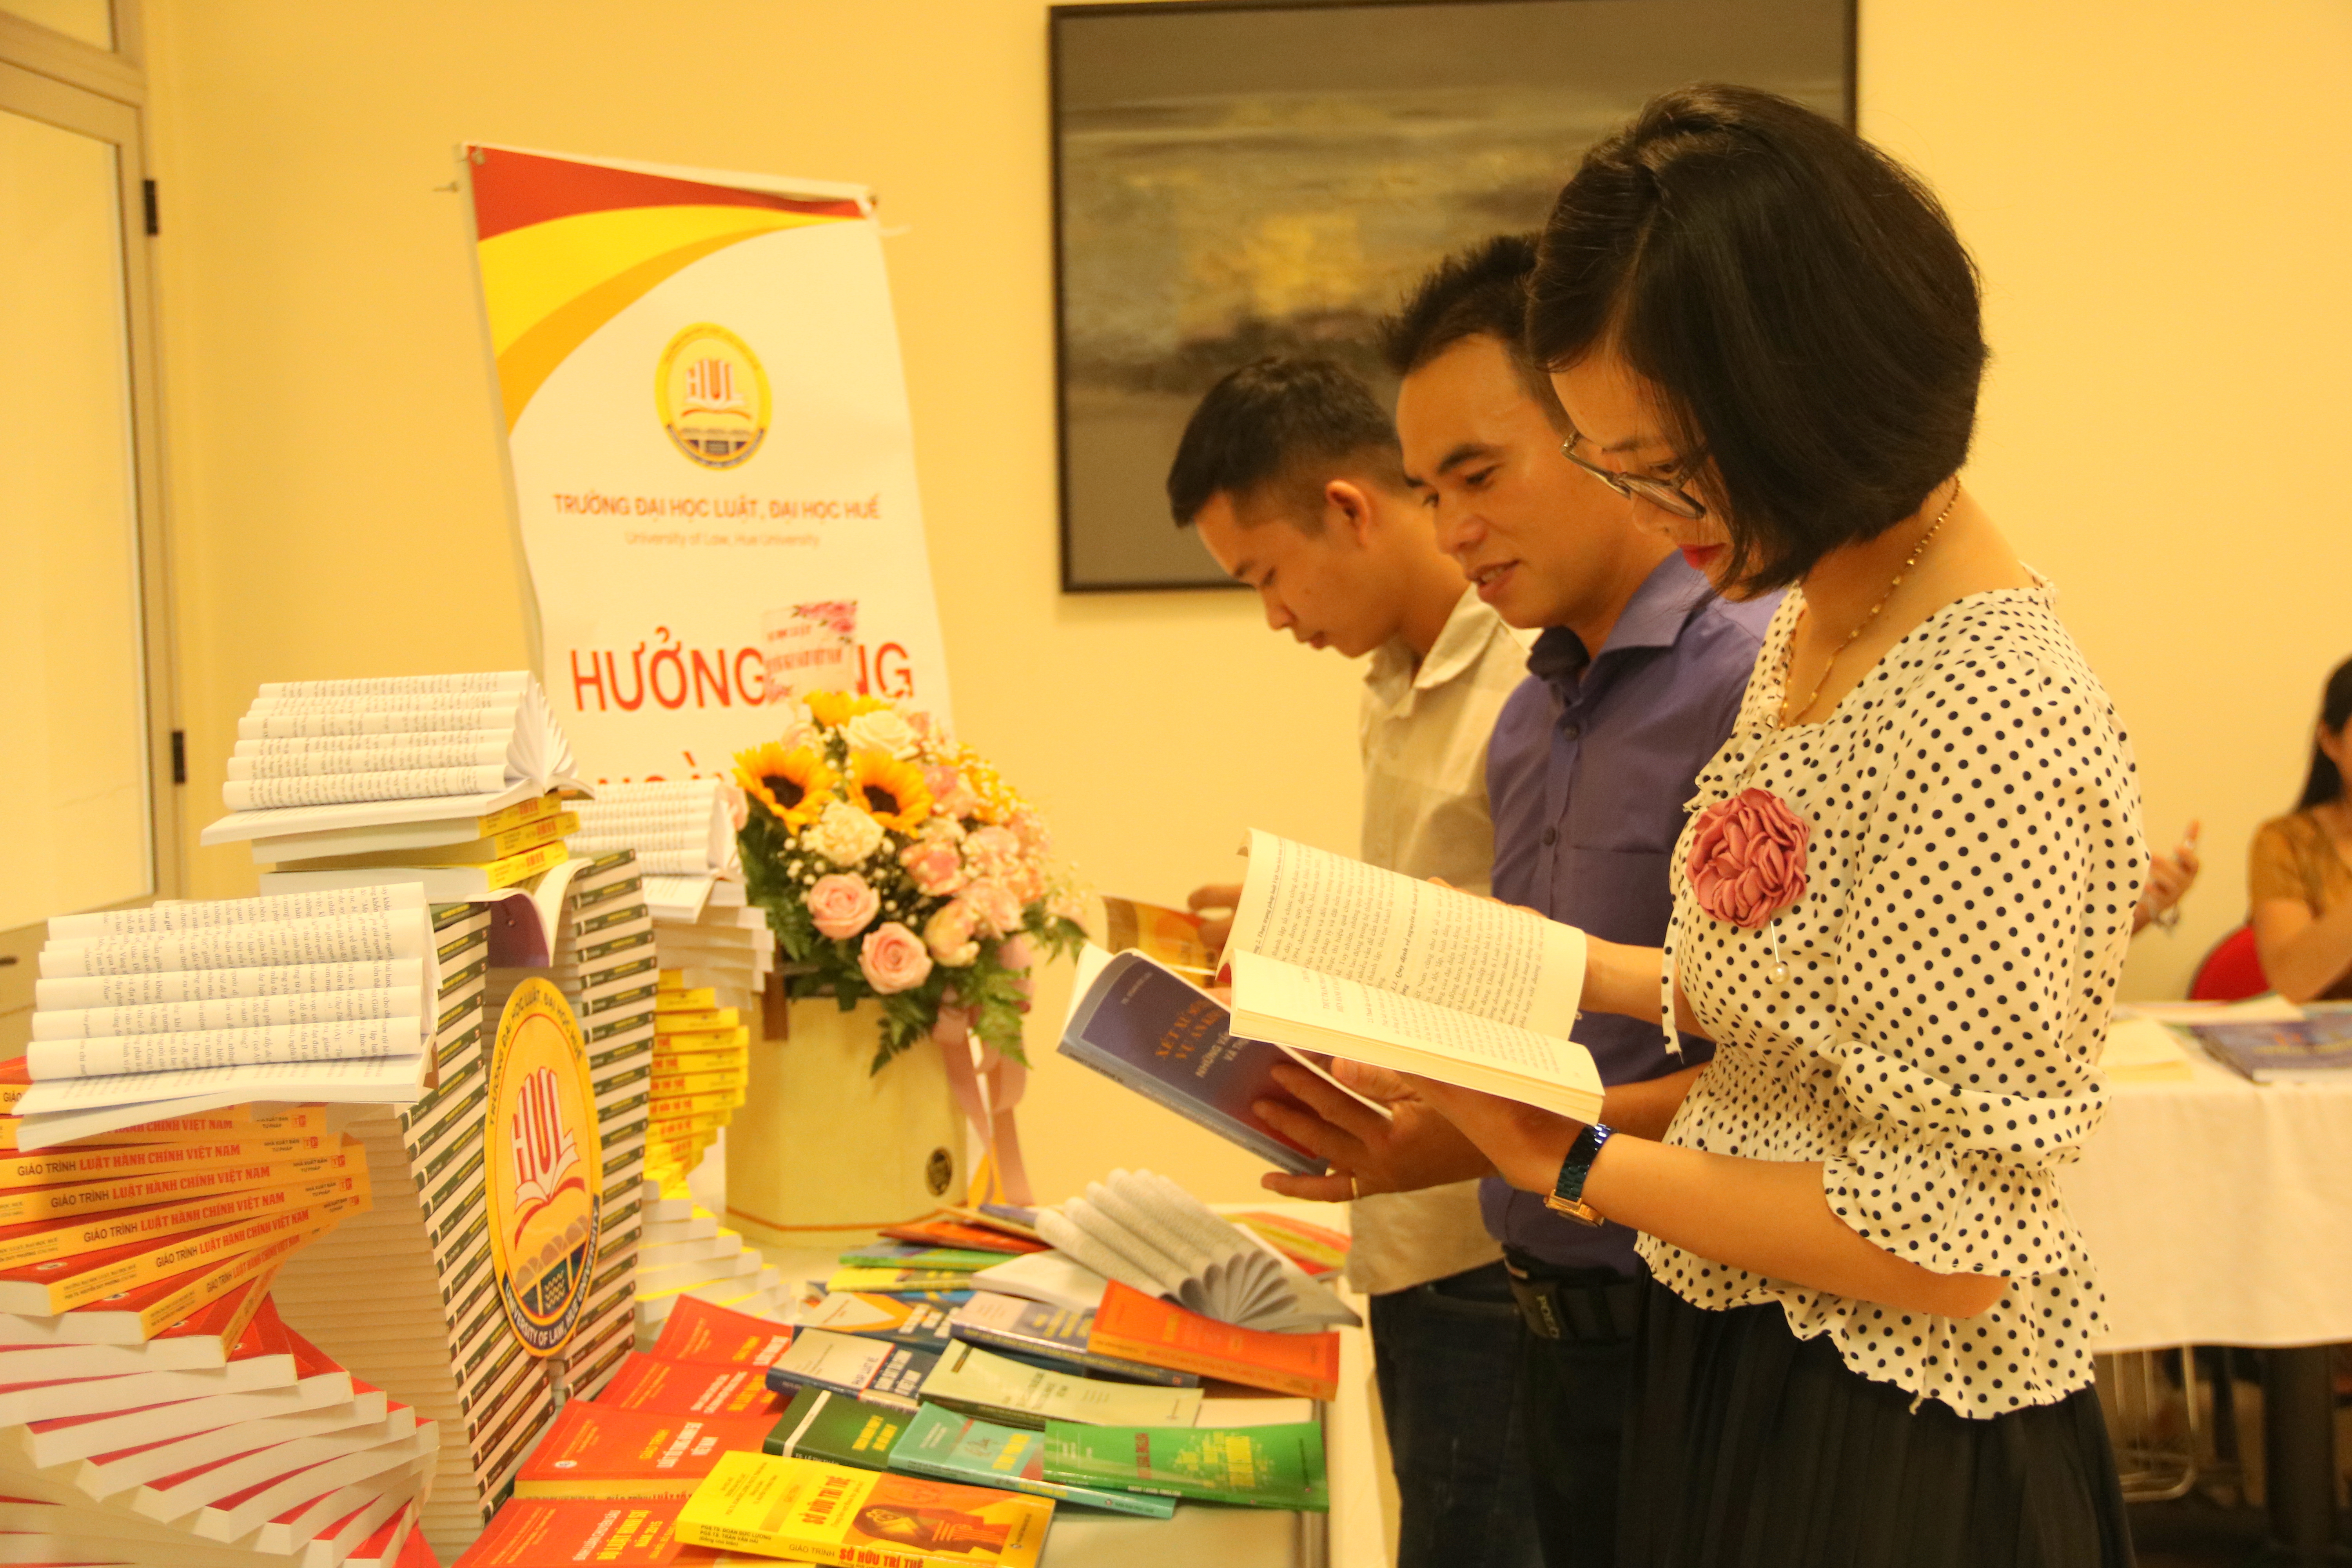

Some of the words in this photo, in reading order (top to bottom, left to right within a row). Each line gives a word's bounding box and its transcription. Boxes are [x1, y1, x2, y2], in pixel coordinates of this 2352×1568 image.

[552, 489, 631, 516] TRƯỜNG
[635, 496, 665, 523] ĐẠI
[669, 497, 710, 523] HỌC
[769, 499, 799, 525] ĐẠI
[801, 500, 841, 525] HỌC
[844, 492, 882, 519] HUẾ
[624, 531, 686, 548] University
[690, 532, 701, 545] of
[764, 532, 820, 549] University
[570, 626, 764, 712] HƯỞNG
[1395, 964, 1404, 977] Quy
[209, 1120, 233, 1129] NAM
[18, 1163, 43, 1176] GIÁO
[46, 1161, 76, 1174] TRÌNH
[80, 1155, 109, 1171] LUẬT
[112, 1152, 145, 1169] HÀNH
[148, 1149, 184, 1163] CHÍNH
[186, 1145, 211, 1160] VIỆT
[215, 1144, 240, 1156] NAM
[51, 1194, 76, 1208] GIÁO
[79, 1190, 109, 1204] TRÌNH
[113, 1185, 142, 1200] LUẬT
[146, 1179, 178, 1194] HÀNH
[180, 1174, 215, 1190] CHÍNH
[218, 1170, 242, 1184] VIỆT
[246, 1166, 270, 1179] NAM
[83, 1228, 107, 1243] GIÁO
[110, 1222, 137, 1237] TRÌNH
[141, 1216, 169, 1232] LUẬT
[172, 1209, 201, 1226] HÀNH
[203, 1202, 235, 1218] CHÍNH
[237, 1196, 259, 1212] VIỆT
[262, 1192, 285, 1206] NAM
[156, 1253, 175, 1268] GIÁO
[175, 1245, 198, 1261] TRÌNH
[199, 1238, 221, 1254] LUẬT
[223, 1231, 246, 1247] HÀNH
[247, 1222, 271, 1239] CHÍNH
[272, 1215, 291, 1231] VIỆT
[292, 1209, 309, 1223] NAM
[506, 1282, 538, 1346] UNIVERSITY
[539, 1331, 548, 1347] OF
[577, 1205, 599, 1299] UNIVERSITY
[789, 1543, 809, 1553] GIÁO
[839, 1546, 856, 1561] SỞ
[857, 1548, 880, 1565] HỮU
[884, 1554, 901, 1568] TRÍ
